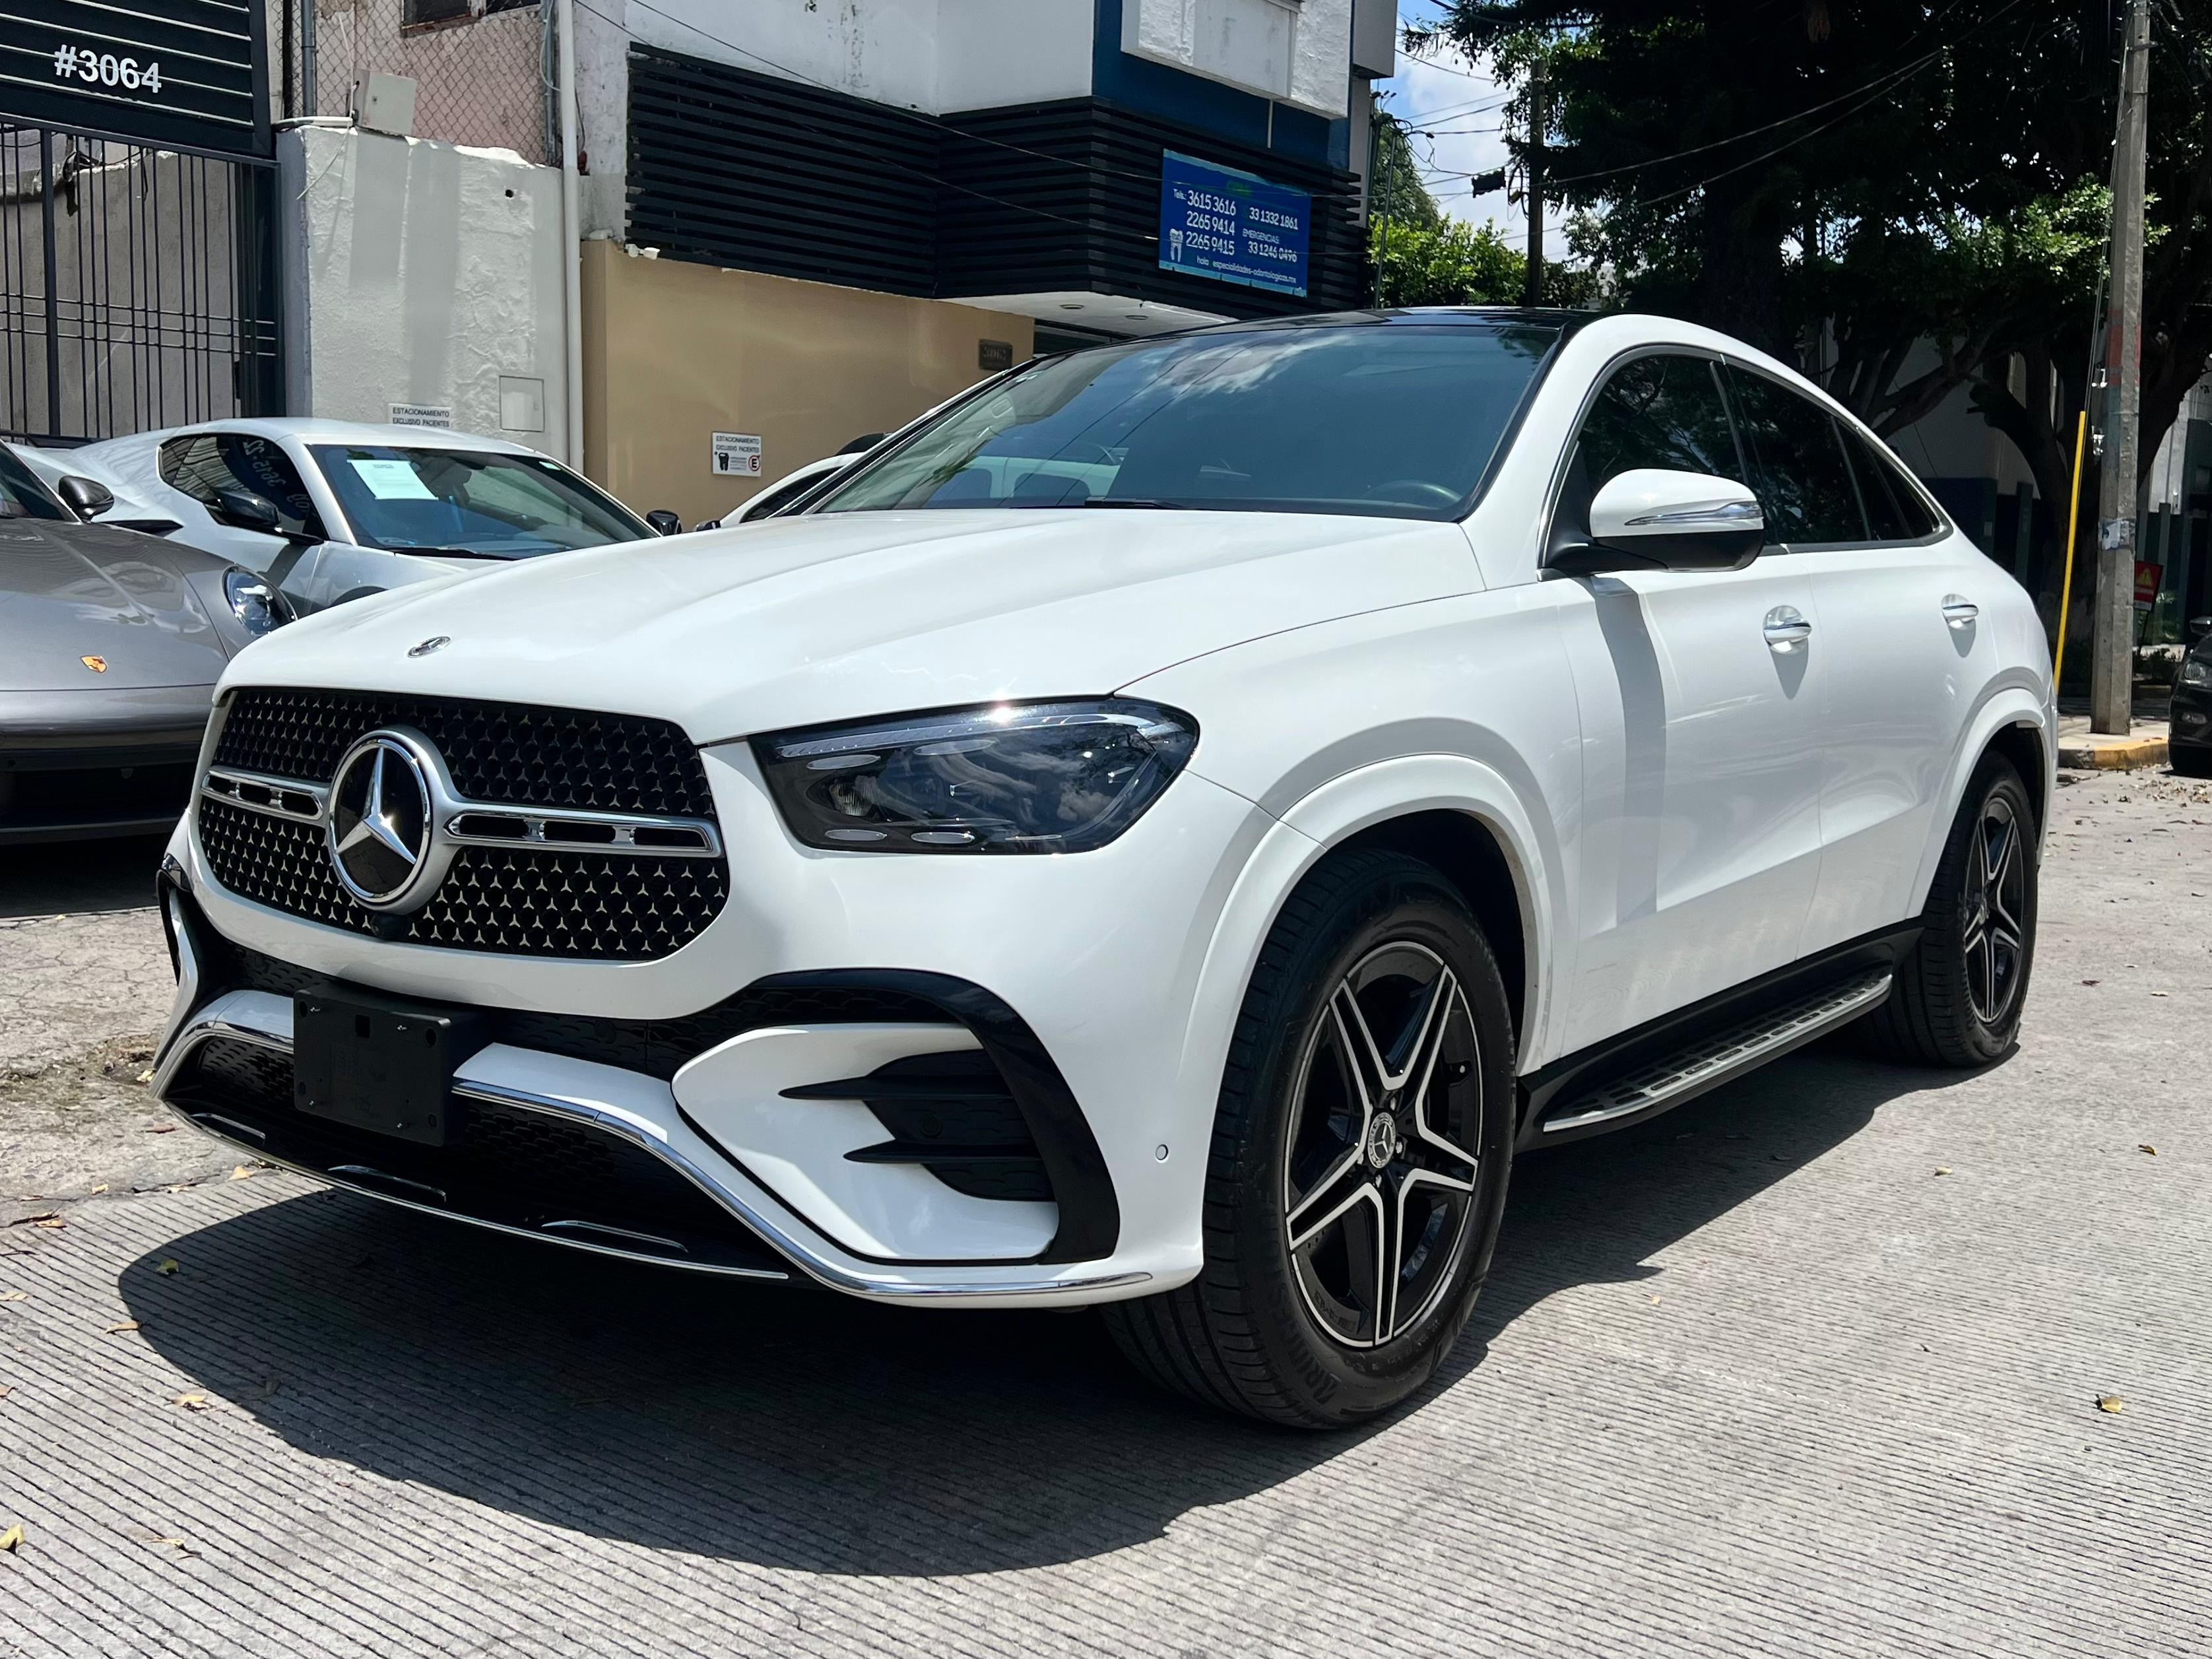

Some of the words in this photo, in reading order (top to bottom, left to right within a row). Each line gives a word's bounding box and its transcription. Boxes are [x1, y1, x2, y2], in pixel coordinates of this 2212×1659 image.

[54, 44, 162, 93] #3064
[1187, 190, 1212, 210] 3615
[1213, 196, 1236, 216] 3616
[1187, 211, 1211, 230] 2265
[1212, 217, 1235, 236] 9414
[1249, 207, 1260, 220] 33
[1260, 210, 1279, 225] 1332
[1280, 214, 1299, 230] 1861
[1186, 231, 1210, 250] 2265
[1212, 237, 1235, 255] 9415
[1248, 241, 1258, 253] 33
[393, 407, 449, 417] ESTACIONAMIENTO
[393, 417, 420, 426] EXCLUSIVO
[422, 419, 449, 428] PACIENTES
[716, 436, 760, 444] ESTACIONAMIENTO
